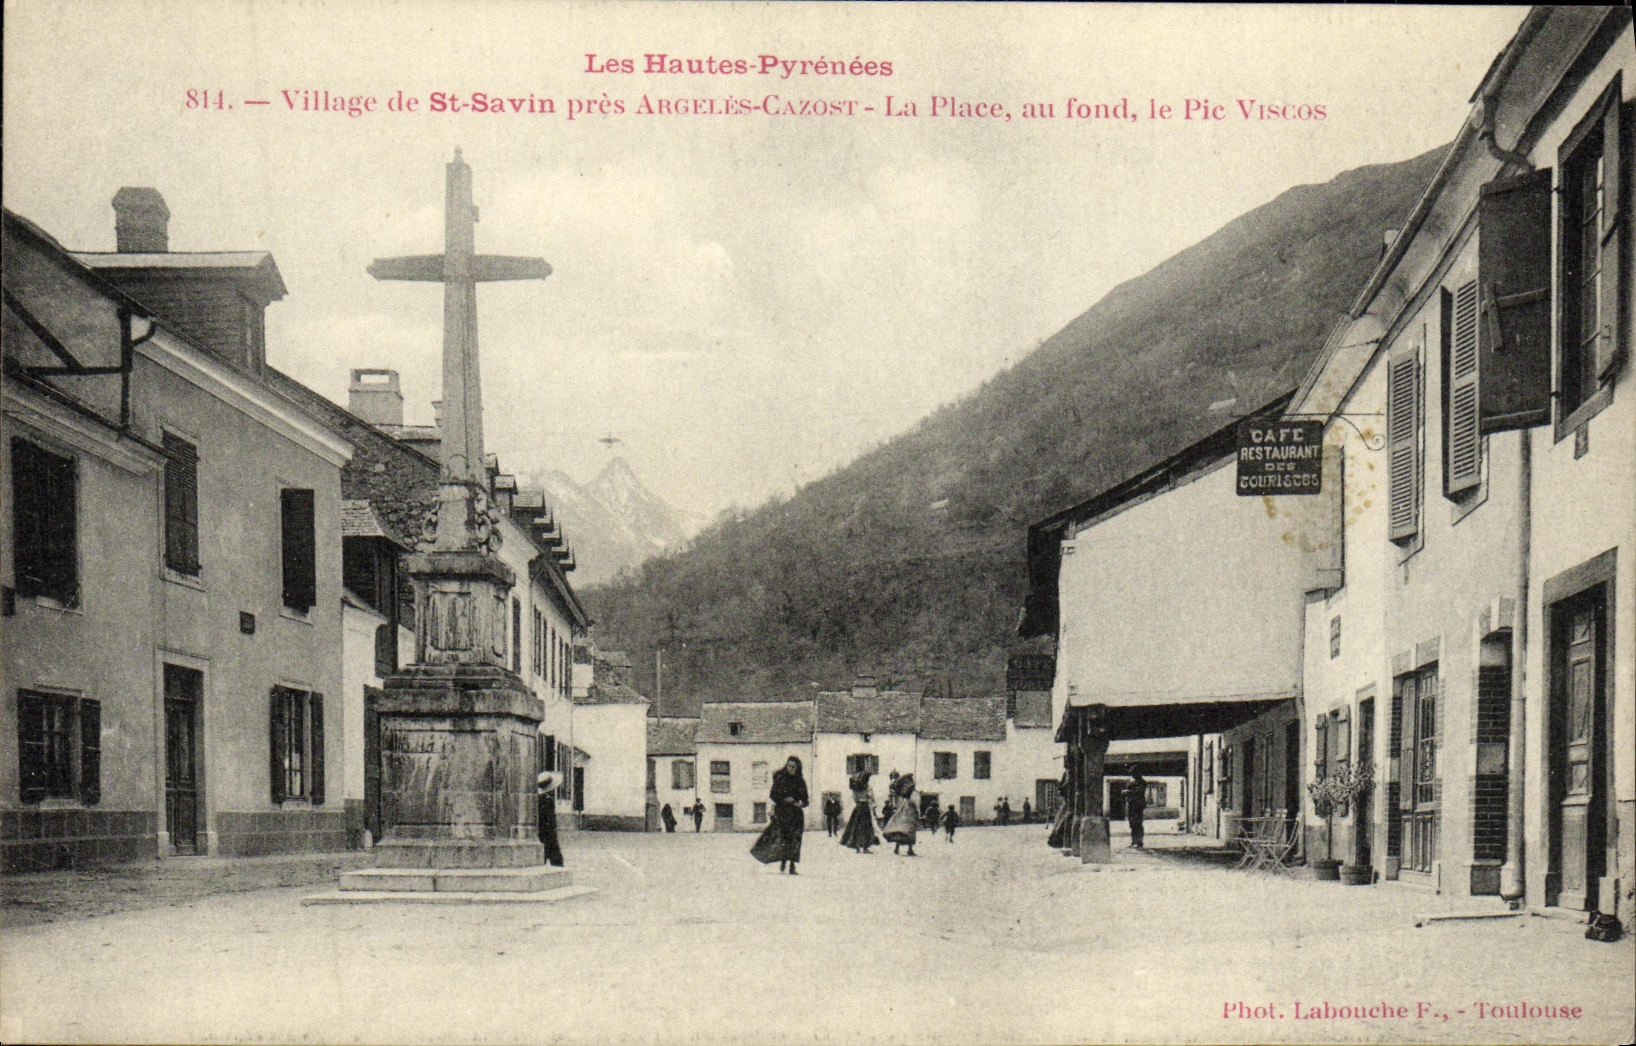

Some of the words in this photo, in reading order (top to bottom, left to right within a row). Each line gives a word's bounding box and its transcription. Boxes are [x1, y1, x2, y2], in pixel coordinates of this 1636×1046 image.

[1240, 445, 1320, 461] RESTAURANT
[1264, 462, 1297, 472] DES
[1240, 474, 1320, 489] TOURISTES
